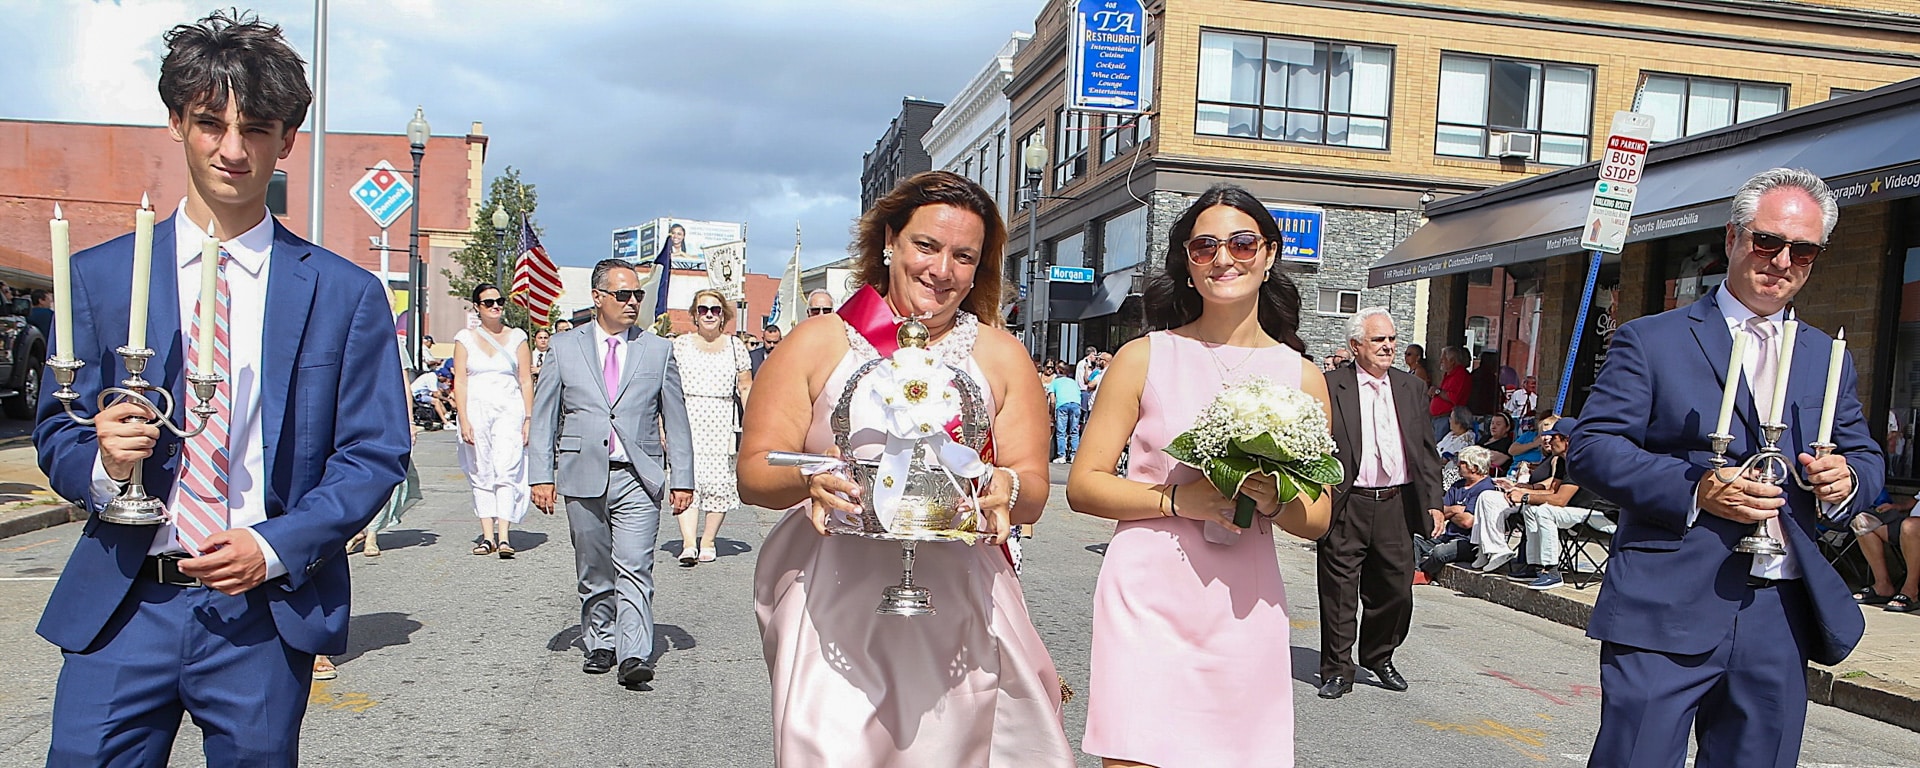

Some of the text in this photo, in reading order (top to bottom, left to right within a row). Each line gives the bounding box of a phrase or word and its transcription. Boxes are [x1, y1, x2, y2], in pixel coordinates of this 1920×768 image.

[1086, 29, 1141, 45] RESTAURANT
[1090, 43, 1136, 53] International
[1099, 51, 1125, 59] Cuisine
[1095, 61, 1127, 70] Cocktails
[1091, 71, 1131, 80] Wine Cellar
[1097, 80, 1123, 89] Lounge
[1088, 87, 1137, 97] Entertainment
[1610, 138, 1646, 152] NO PARKING
[1611, 151, 1637, 166] BUS
[1605, 165, 1637, 180] STOP
[1828, 173, 1920, 201] ography Videog
[374, 188, 406, 216] Domino's
[1277, 217, 1313, 234] URANT
[1546, 238, 1562, 250] Metal
[1562, 236, 1579, 247] Prints
[1632, 221, 1655, 236] Sports
[1655, 212, 1699, 230] Memorabilia
[1282, 246, 1299, 255] EAR
[1393, 269, 1404, 278] Photo
[1404, 266, 1412, 276] Lab
[1417, 264, 1428, 275] Copy
[1429, 262, 1442, 272] Center
[1448, 254, 1473, 268] Customized
[1474, 252, 1494, 264] Framing
[1053, 267, 1084, 280] Morgan
